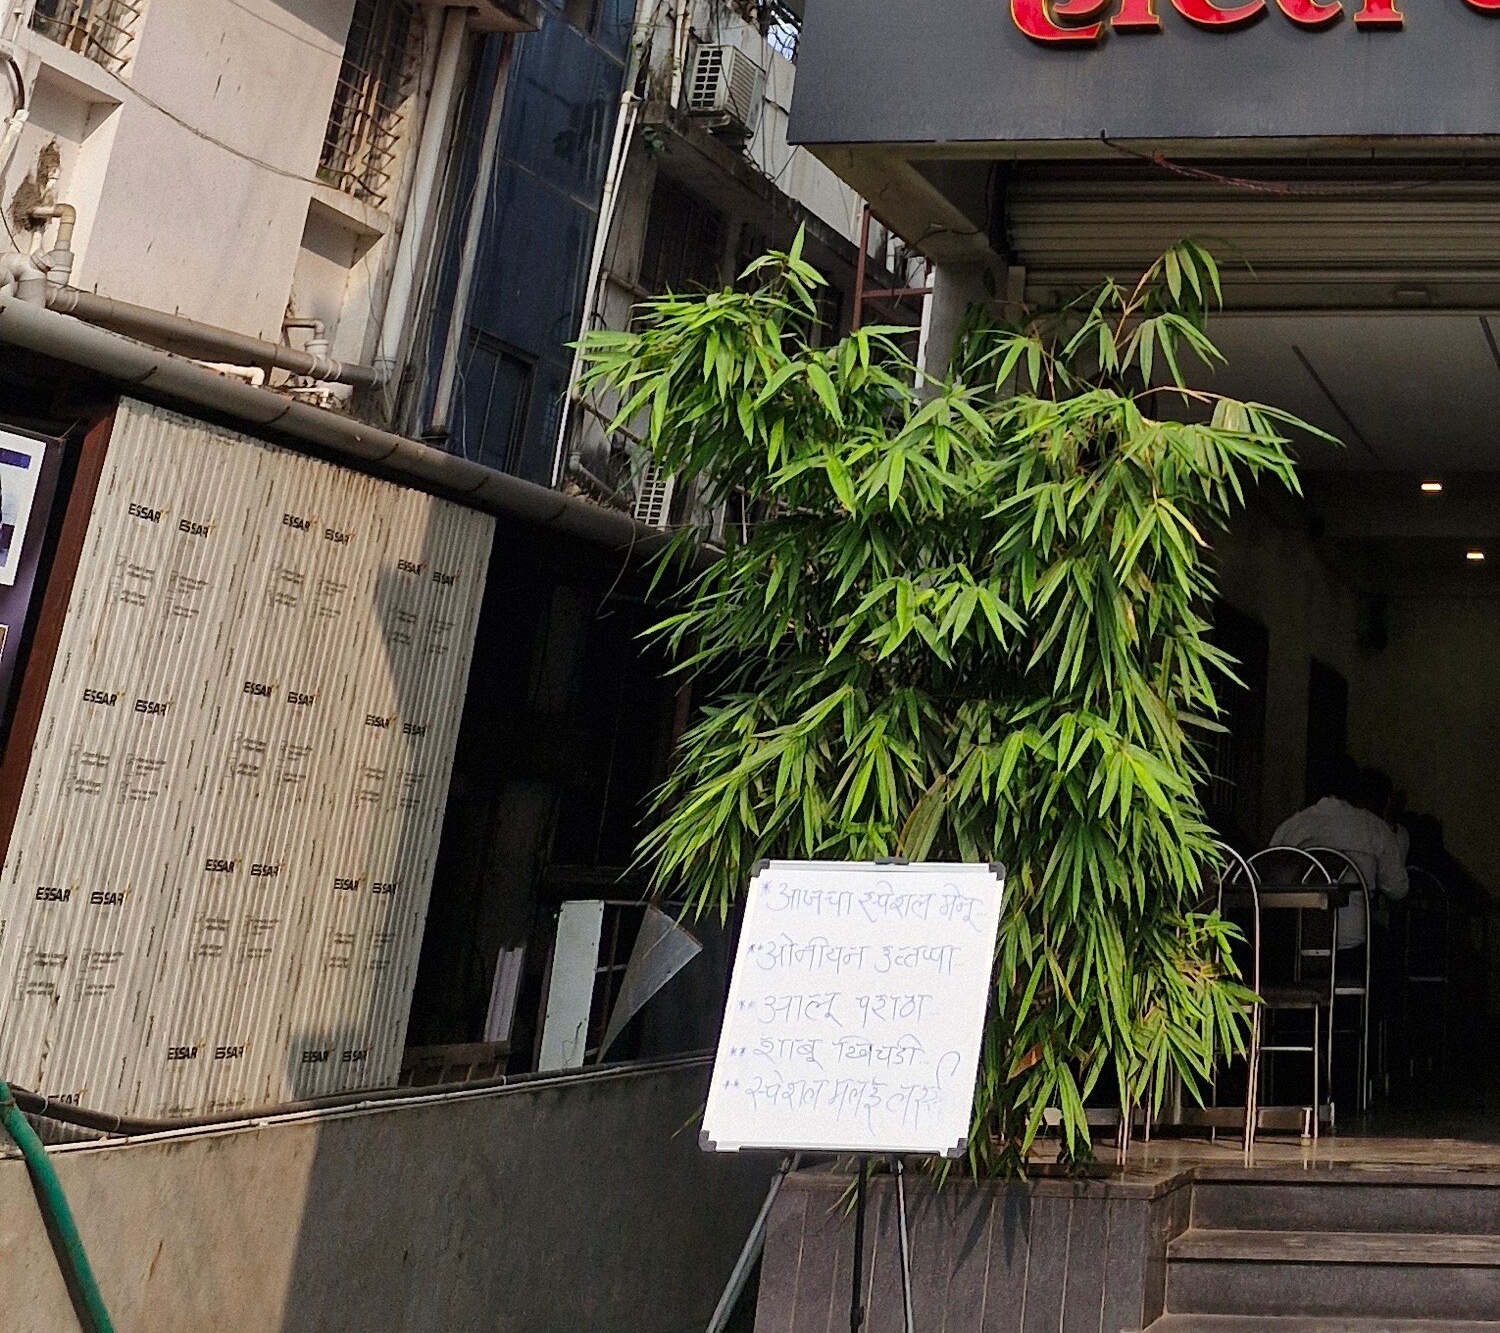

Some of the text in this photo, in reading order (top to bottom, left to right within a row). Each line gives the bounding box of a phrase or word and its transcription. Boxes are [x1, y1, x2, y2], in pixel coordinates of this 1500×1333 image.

[128, 503, 161, 523] ESSAR
[282, 514, 310, 532] ESSAR
[397, 559, 422, 576] ESSAR
[83, 688, 117, 707] ESSAR
[243, 682, 272, 698] ESSAR
[135, 699, 167, 717] ESSAR
[365, 714, 390, 730] ESSAR
[205, 859, 235, 874] ESSAR
[334, 878, 359, 891] ESSAR
[35, 887, 71, 902] ESSAR
[90, 891, 124, 905] ESSAR
[766, 882, 853, 916] आजचा
[858, 880, 936, 923] स्पेशल
[756, 932, 870, 974] ओनीयन
[758, 992, 843, 1027] आलू
[168, 1046, 198, 1061] ESSAR
[302, 1050, 329, 1063] ESSAR
[753, 1037, 824, 1069] शाबू
[745, 1070, 830, 1111] स्पेशल
